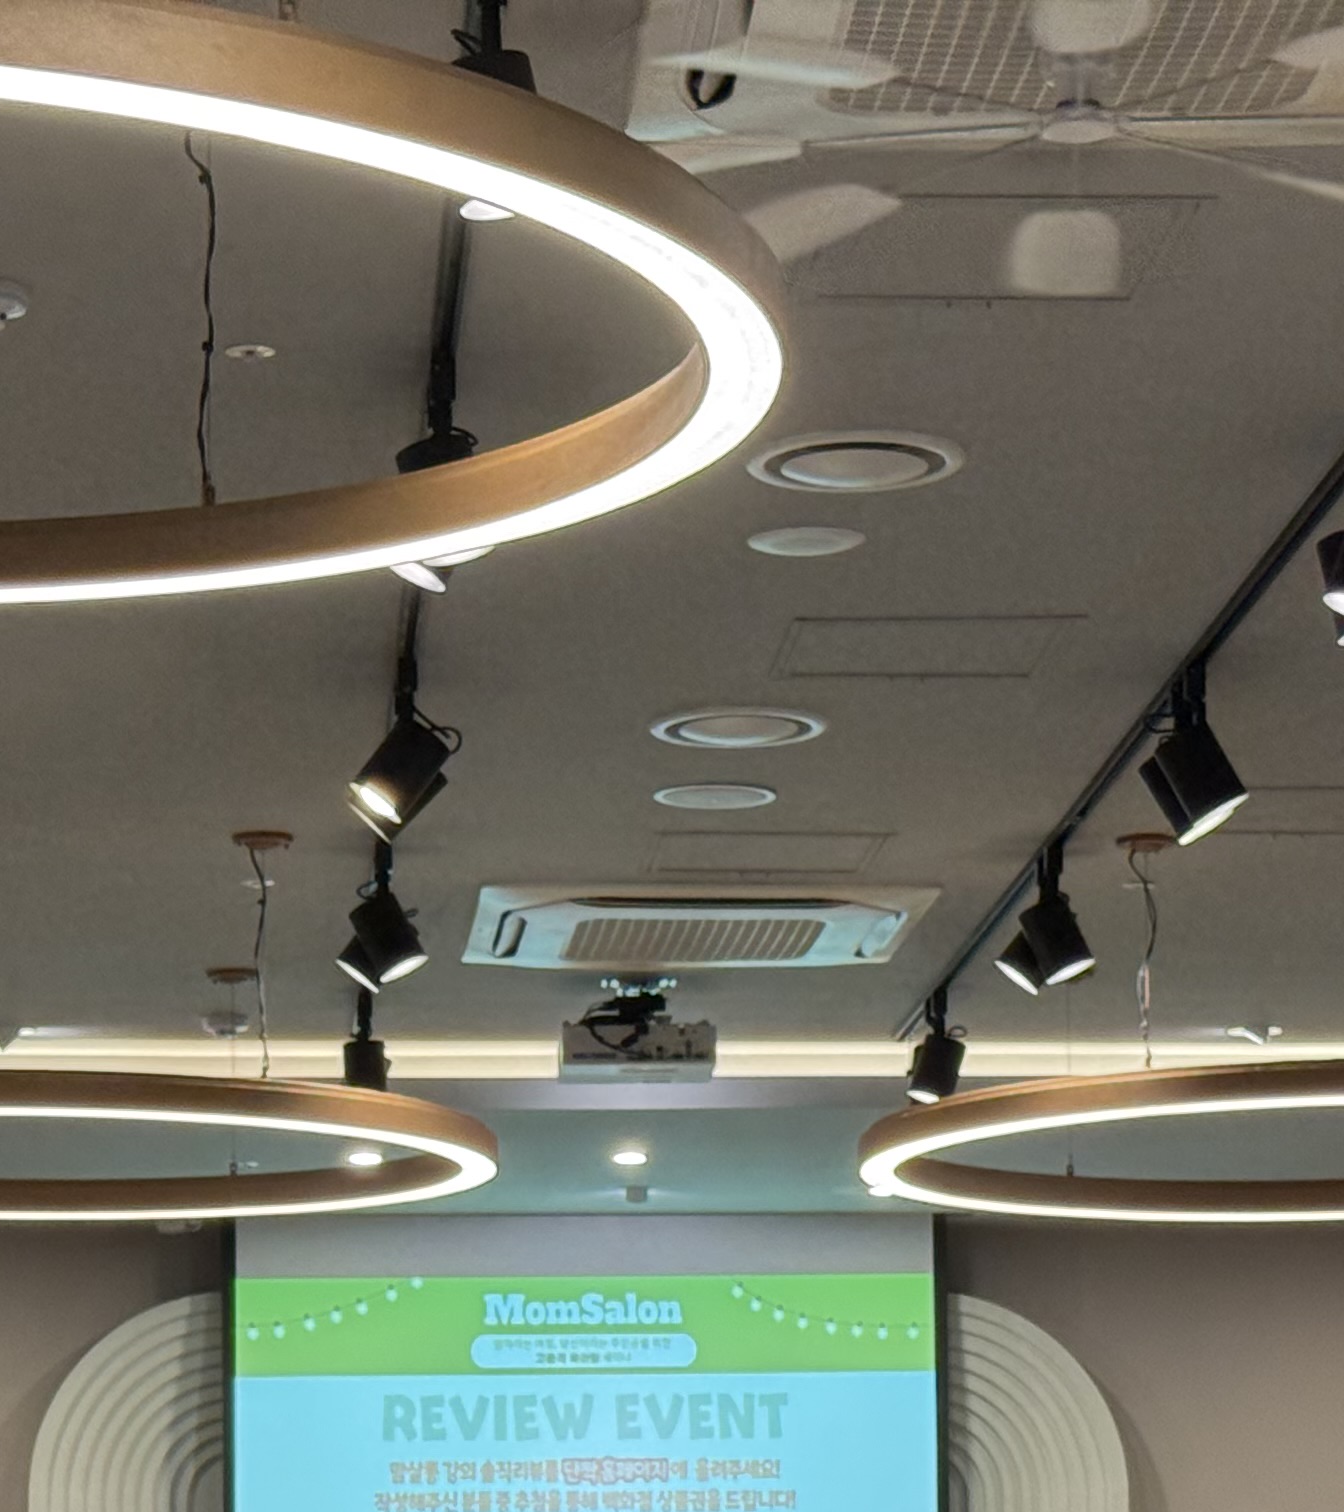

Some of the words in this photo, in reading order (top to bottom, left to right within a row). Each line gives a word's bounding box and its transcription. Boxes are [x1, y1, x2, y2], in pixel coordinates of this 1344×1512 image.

[483, 1291, 683, 1326] MomSalon
[382, 1393, 595, 1442] REVIEW
[614, 1392, 789, 1440] EVENT
